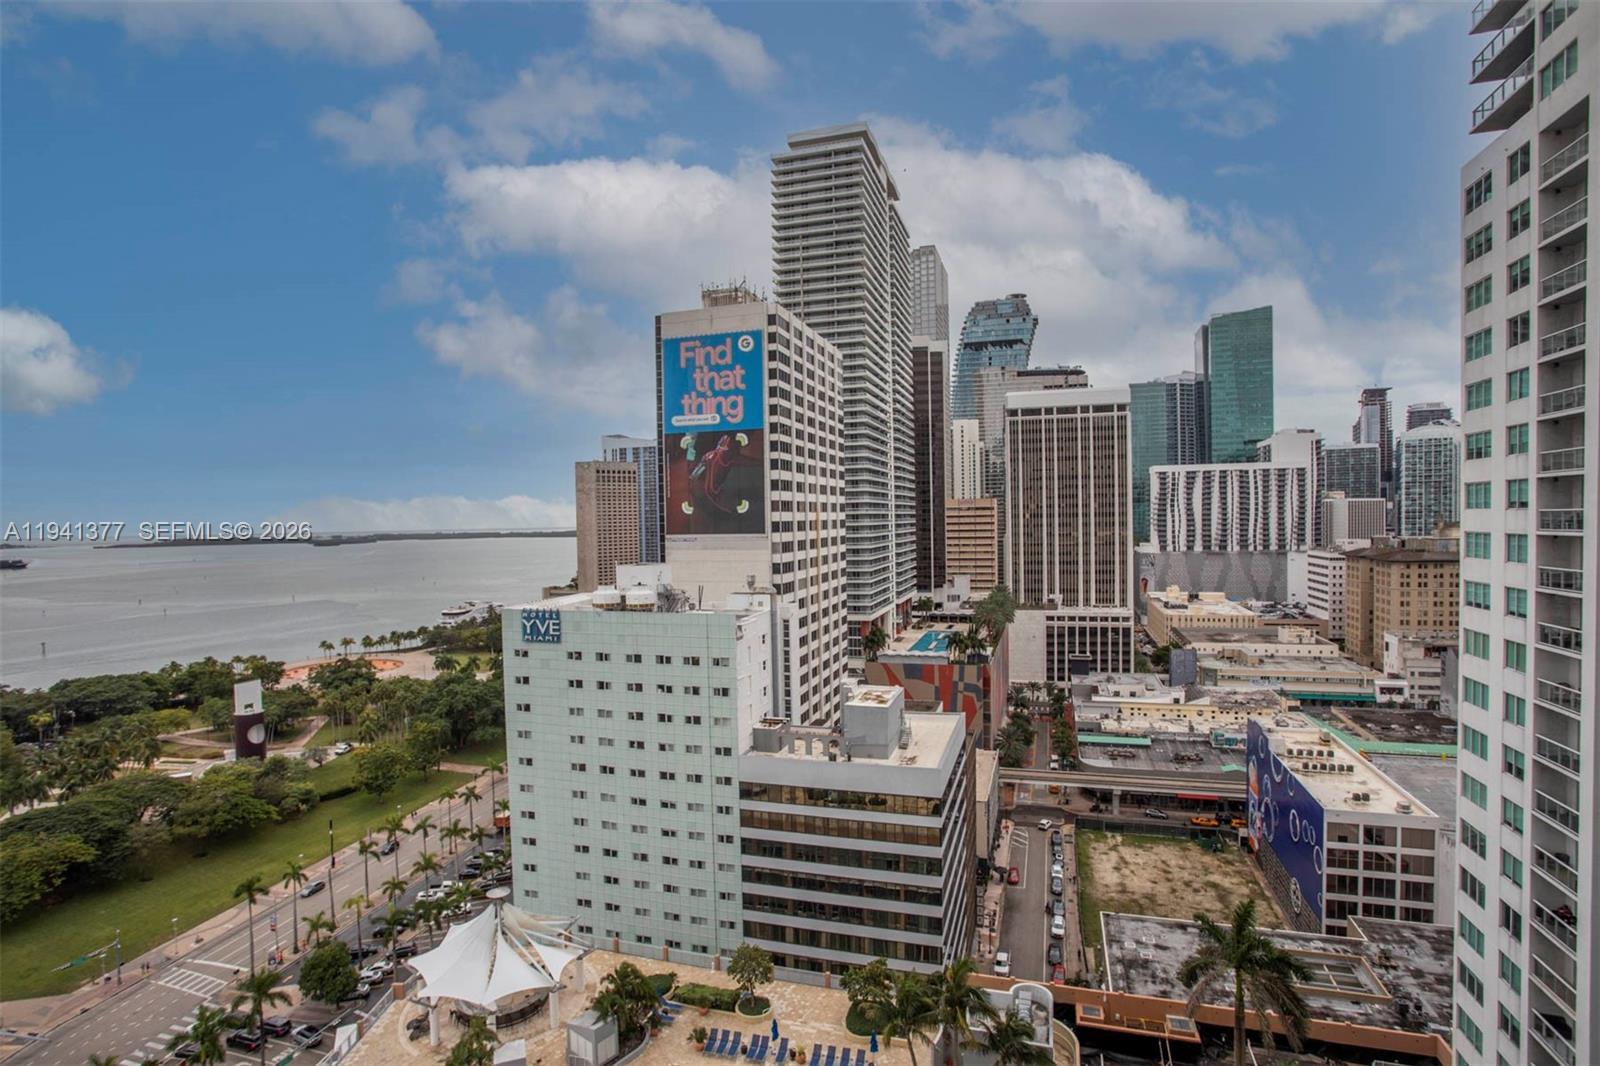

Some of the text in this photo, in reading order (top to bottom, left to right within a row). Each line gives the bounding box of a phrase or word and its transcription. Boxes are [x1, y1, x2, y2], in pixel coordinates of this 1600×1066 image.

[679, 337, 732, 368] Find
[693, 364, 746, 392] that
[681, 390, 744, 424] thing
[521, 619, 560, 635] YVE
